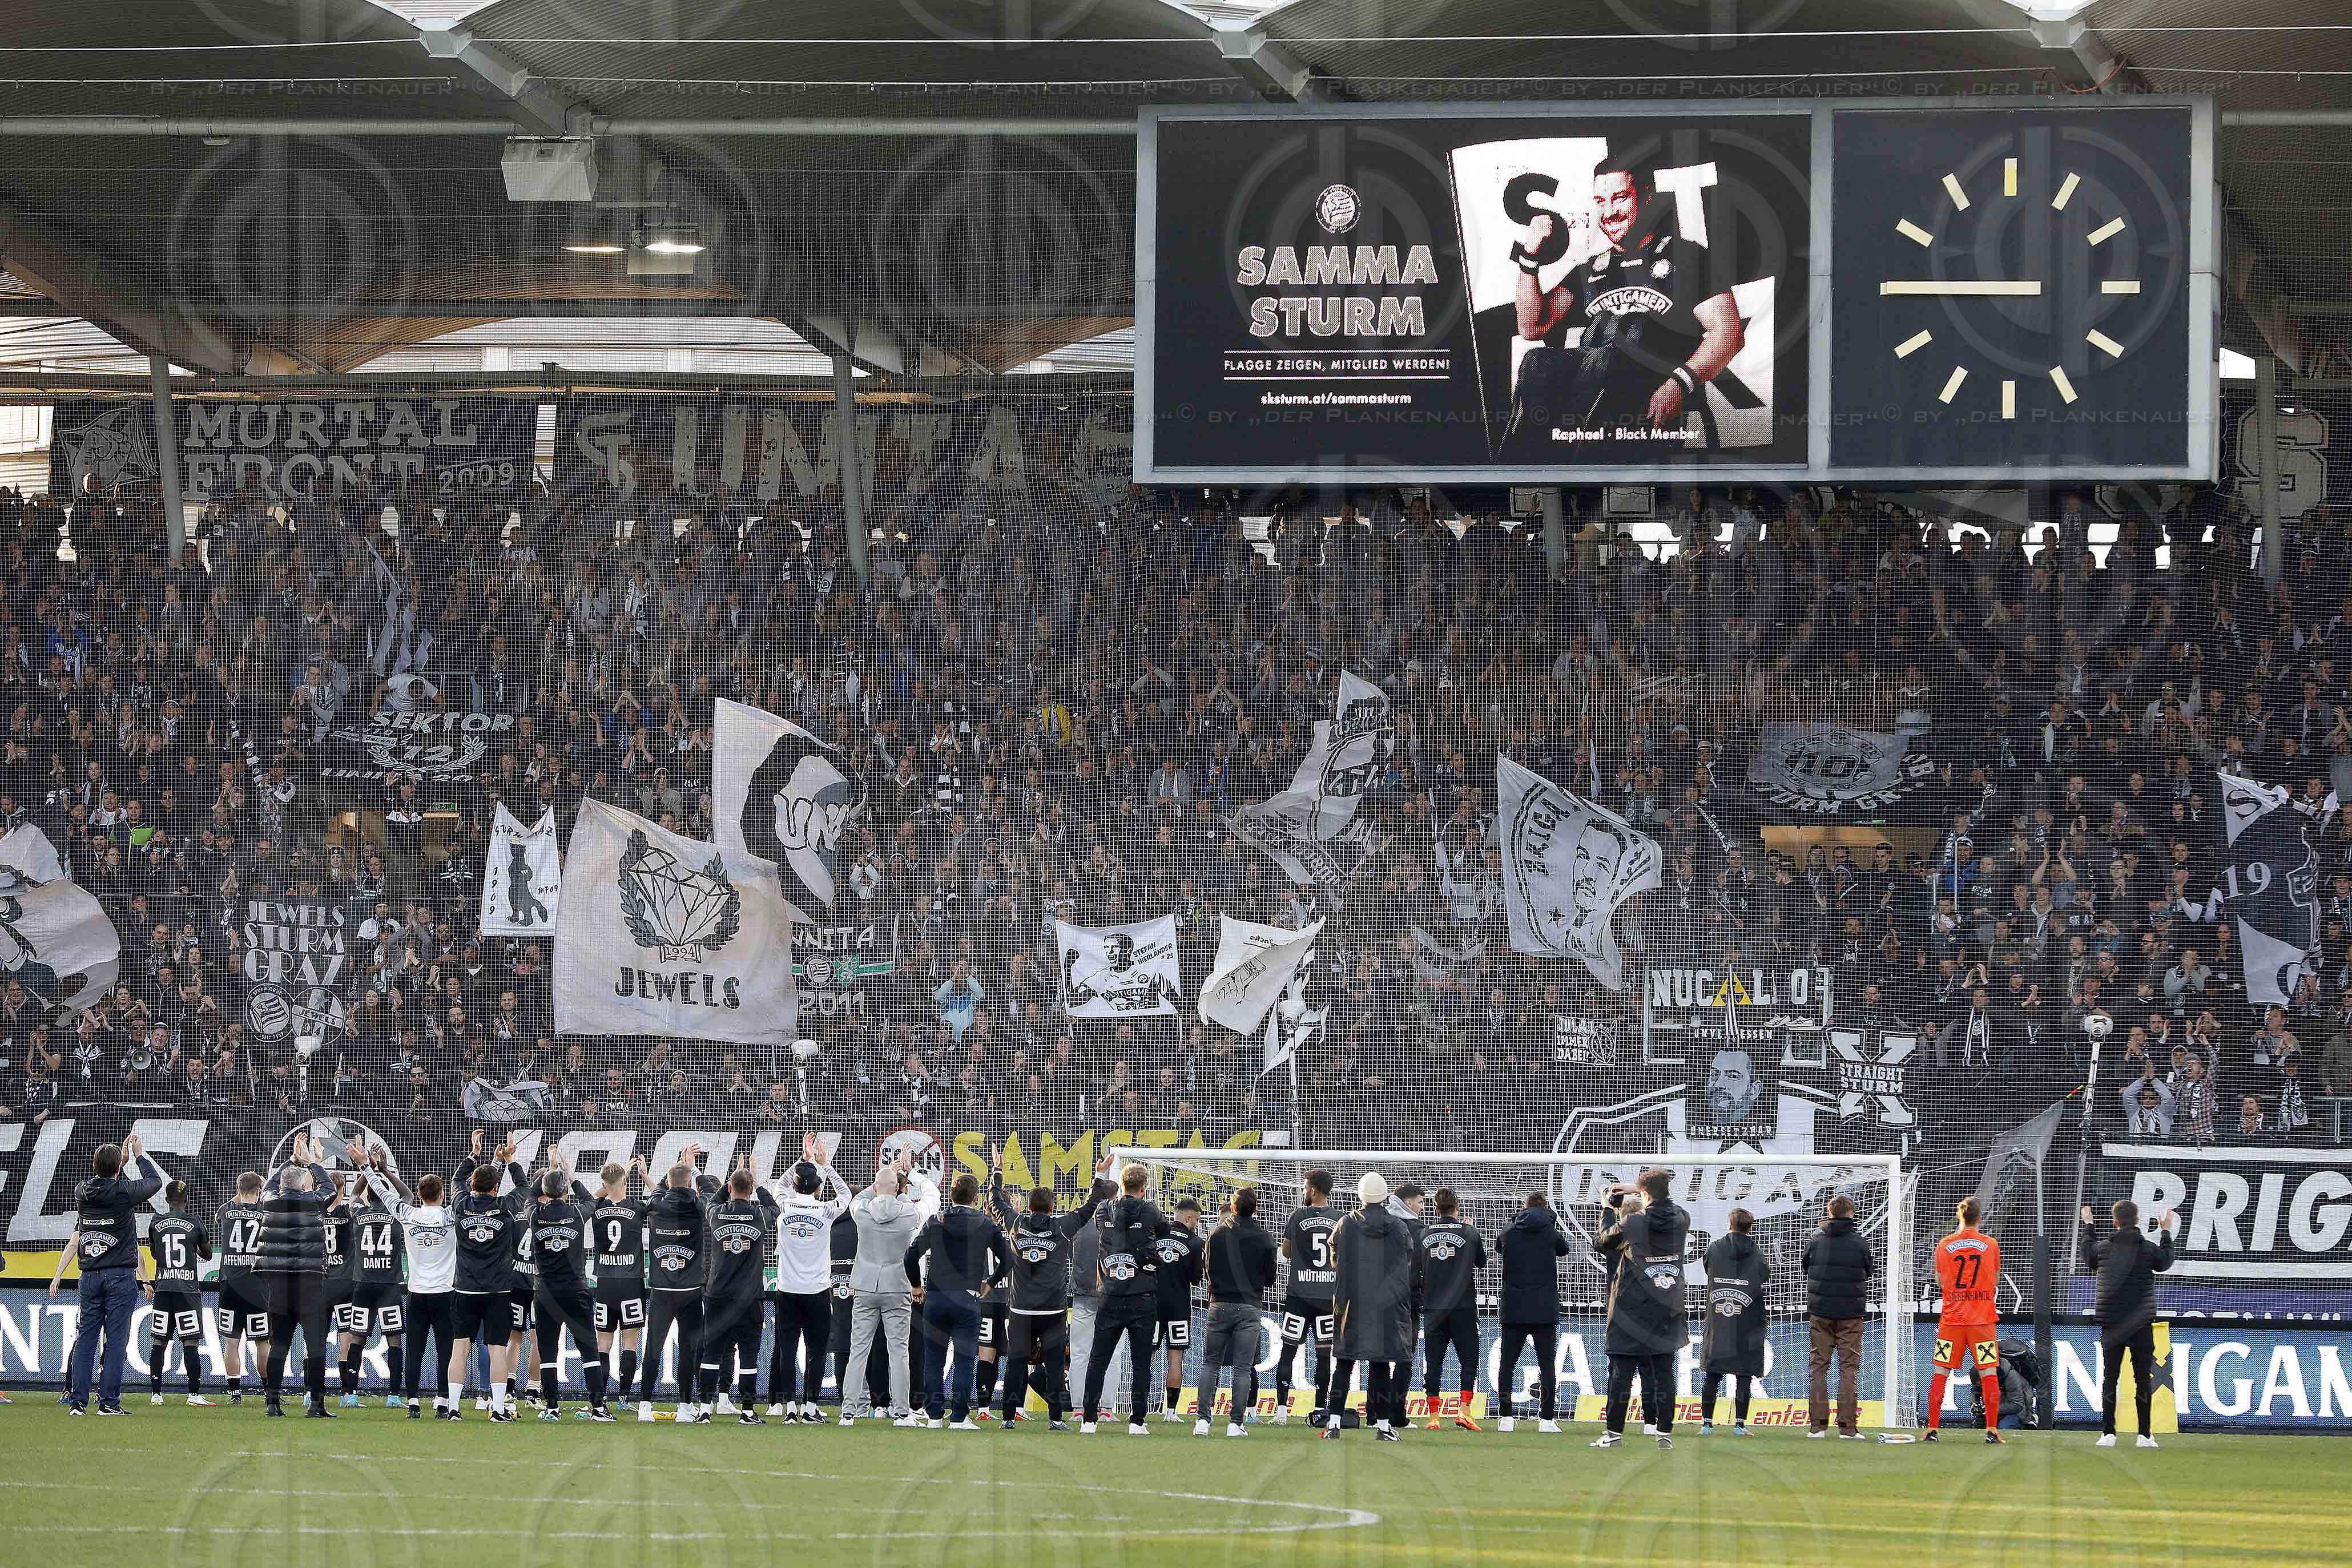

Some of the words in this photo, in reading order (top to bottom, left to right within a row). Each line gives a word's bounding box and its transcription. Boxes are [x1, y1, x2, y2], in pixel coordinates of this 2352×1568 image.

[1237, 245, 1439, 286] SAMMA
[1249, 296, 1426, 337] STURM
[1224, 360, 1272, 370] FLAGGE
[1276, 360, 1326, 372] ZEIGEN,
[1331, 359, 1388, 370] MITGLIED
[1392, 358, 1451, 370] WERDEN!
[1260, 392, 1412, 406] sksturm.at/sammasturm
[183, 400, 477, 448] MURTAL
[1552, 428, 1605, 443] Raphael
[1616, 428, 1648, 440] Black
[1654, 428, 1701, 440] Member
[182, 452, 425, 502] FRONT
[438, 462, 514, 494] 2009
[368, 711, 514, 733] SEKTOR
[244, 900, 344, 927] JEWELS
[244, 922, 345, 953] STURM
[1133, 942, 1157, 959] STEFAN
[245, 949, 345, 985] GRAZ
[615, 966, 741, 1009] JEWELS
[299, 1008, 336, 1026] JEWELS
[1839, 1062, 1905, 1080] STRAIGHT
[1840, 1077, 1904, 1094] STURM
[597, 1208, 634, 1218] PUNTIGAMER
[784, 1215, 823, 1228] PUNTIGAMER
[158, 1219, 193, 1231] PUNTIGAMER
[462, 1217, 501, 1230] PUNTIGAMER
[81, 1232, 117, 1245] PUNTIGAMER
[229, 1219, 258, 1253] 42
[360, 1224, 393, 1256] 44
[537, 1227, 577, 1240] PUNTIGAMER
[607, 1220, 622, 1252] 9
[716, 1225, 759, 1241] PUNTIGAMER
[1424, 1233, 1465, 1247] PUNTIGAMER
[161, 1233, 187, 1268] 15
[517, 1228, 532, 1260] 4
[656, 1246, 693, 1259] PUNTIGAMER
[1018, 1238, 1055, 1250] PUNTIGAMER
[1312, 1232, 1327, 1268] 5
[1949, 1239, 1986, 1251] PUNTIGAMER
[364, 1257, 392, 1269] DANTE
[599, 1253, 634, 1266] HØJLUND
[1954, 1254, 1982, 1289] 27
[1711, 1289, 1751, 1306] PUNTIGAMER
